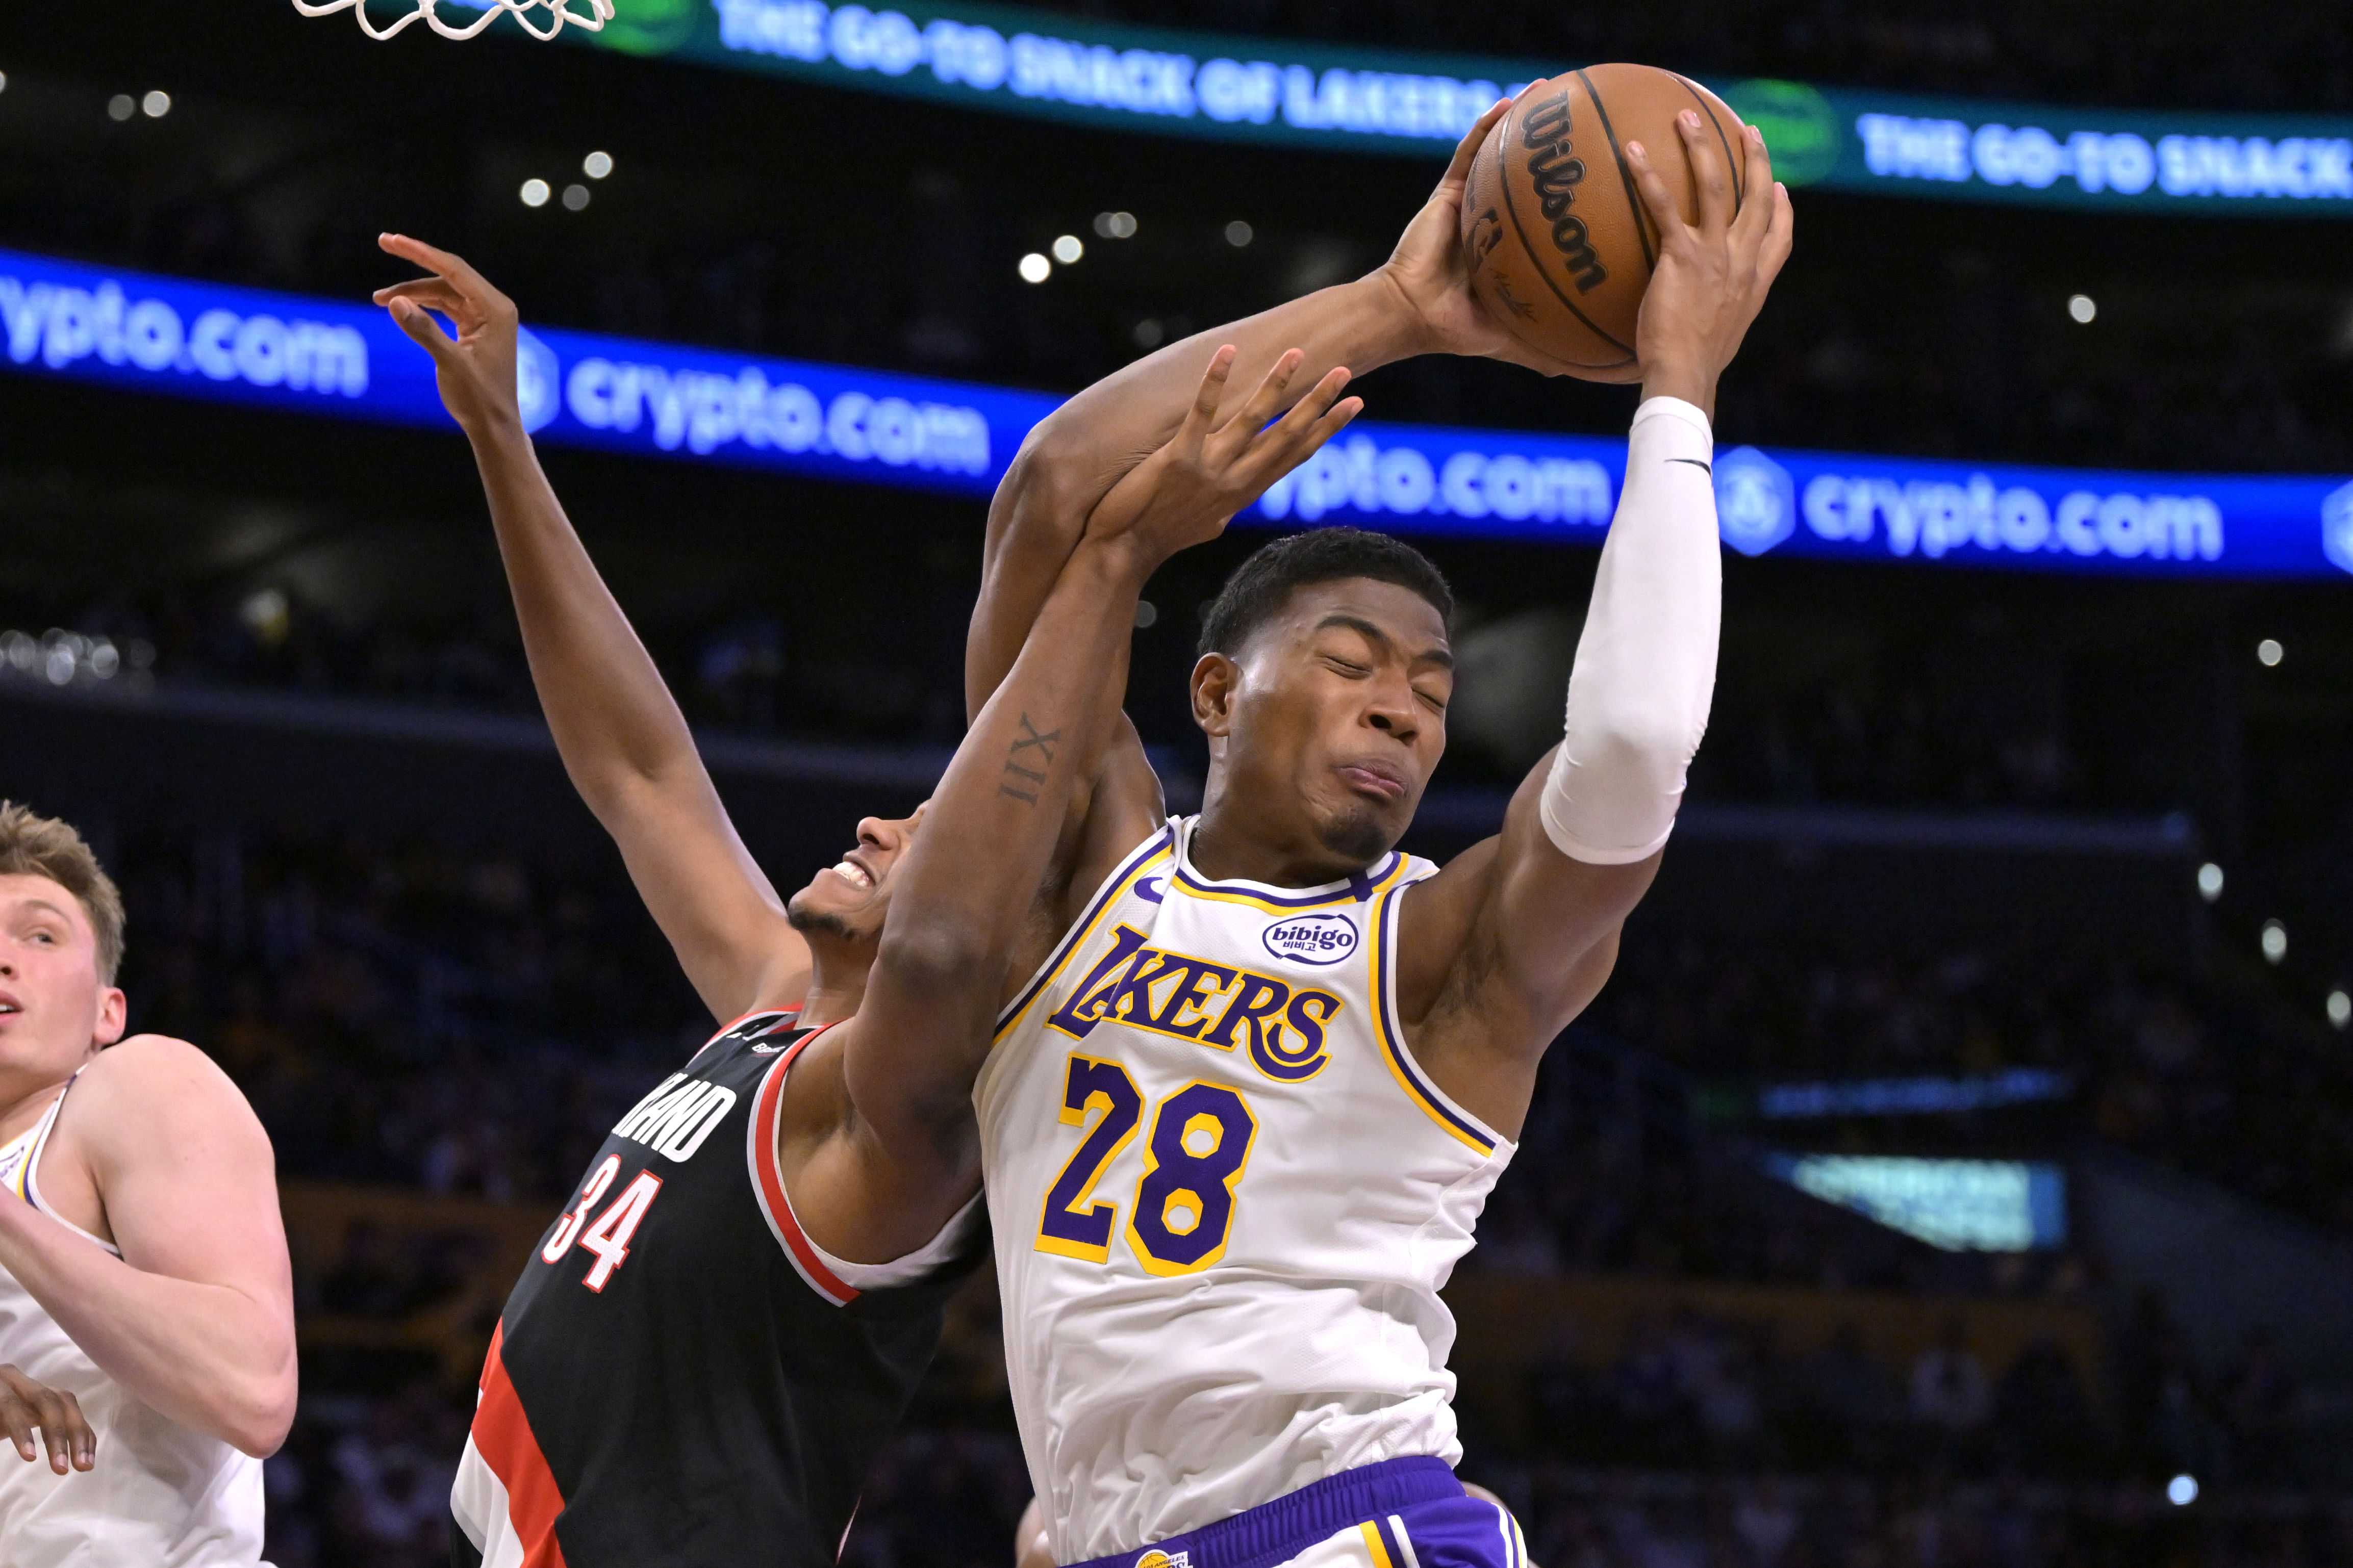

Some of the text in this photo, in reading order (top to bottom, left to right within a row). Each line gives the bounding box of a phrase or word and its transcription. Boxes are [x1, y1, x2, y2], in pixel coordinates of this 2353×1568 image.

[714, 0, 828, 62] THE
[829, 5, 1006, 89] GO-TO
[1007, 33, 1195, 117] SNACK
[1195, 58, 1279, 124] OF
[1520, 89, 1608, 297] Wilson
[1857, 114, 2353, 199] THE GO-TO SNACK
[567, 357, 990, 475] crypto.com
[1803, 472, 2223, 560] crypto.com
[1272, 925, 1353, 950] bibigo
[1282, 941, 1317, 952] 비비고
[1034, 1051, 1259, 1278] 28
[541, 1153, 663, 1294] 34
[1154, 1555, 1185, 1567] ANGELES
